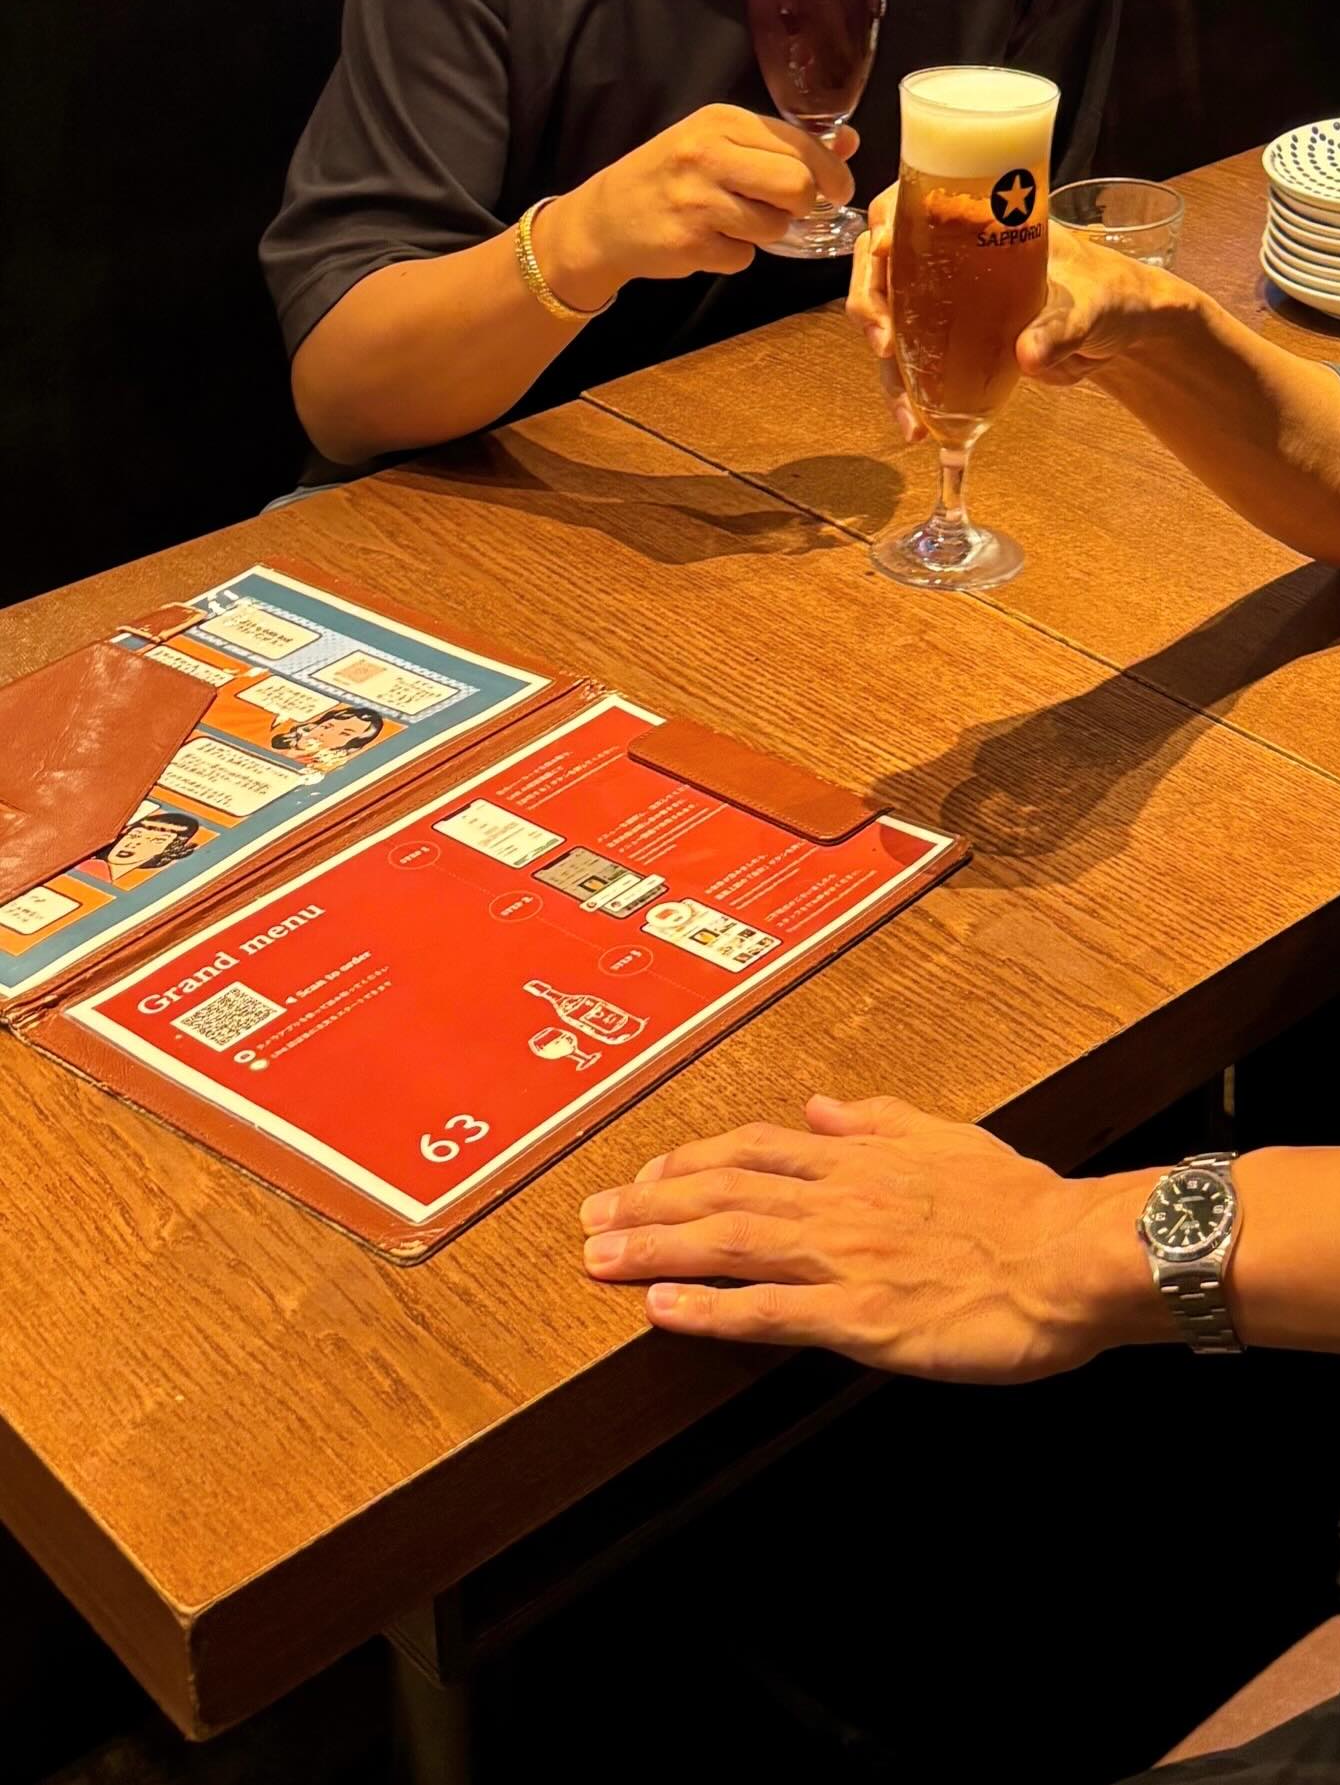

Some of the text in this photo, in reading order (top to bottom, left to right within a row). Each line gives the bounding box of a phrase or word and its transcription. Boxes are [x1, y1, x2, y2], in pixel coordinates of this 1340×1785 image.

[976, 223, 1042, 247] SAPPORO
[137, 904, 326, 1015] Grand menu
[295, 951, 372, 998] Scan to order
[420, 1114, 489, 1162] 63
